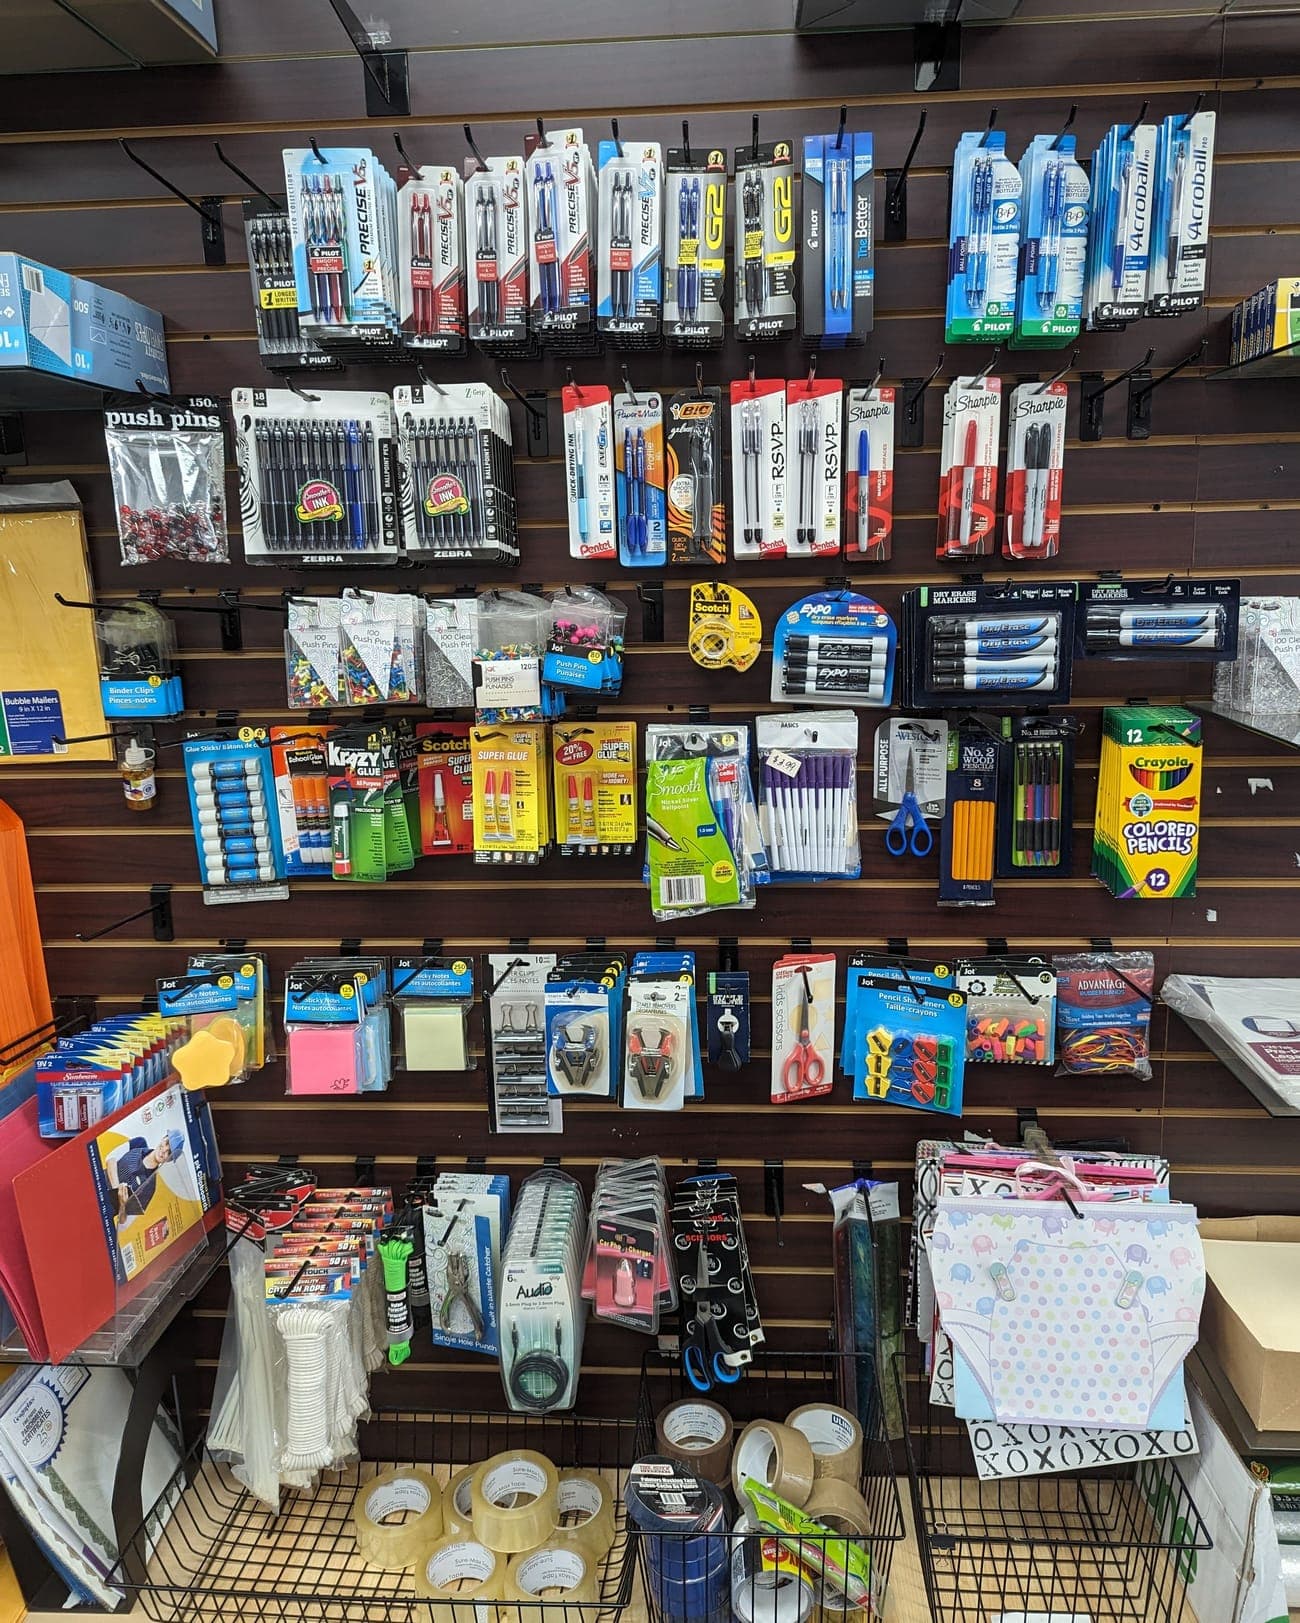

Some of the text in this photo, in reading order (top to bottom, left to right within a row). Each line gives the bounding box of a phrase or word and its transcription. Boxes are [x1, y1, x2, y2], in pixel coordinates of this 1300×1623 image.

[1186, 148, 1207, 240] Acroball
[569, 184, 577, 234] PRECISE
[774, 176, 792, 243] G2
[1130, 161, 1148, 252] Acroball
[355, 187, 372, 255] PRECISE
[641, 198, 650, 246] PRECISE
[706, 184, 724, 250] G2
[507, 208, 516, 254] PRECISE
[441, 219, 450, 266] PRECISE
[74, 300, 89, 314] 500
[1171, 297, 1199, 306] PILOT
[554, 312, 578, 321] PILOT
[1112, 307, 1139, 315] PILOT
[684, 326, 710, 334] PILOT
[758, 321, 783, 329] PILOT
[984, 322, 1012, 332] PILOT
[1052, 324, 1078, 333] PILOT
[490, 329, 514, 337] PILOT
[424, 338, 448, 346] PILOT
[254, 392, 265, 400] 18
[955, 394, 1000, 412] Sharpie
[1016, 398, 1066, 418] Sharpie
[616, 407, 661, 420] Paper Mate
[682, 404, 710, 416] BIC
[850, 404, 891, 422] Sharpie
[105, 408, 221, 431] push pins
[647, 442, 656, 471] Profile
[568, 448, 577, 502] QUICK-DRYING
[439, 490, 454, 502] INK
[653, 522, 661, 532] 2
[580, 540, 612, 555] Pentel
[759, 539, 786, 552] Pentel
[810, 540, 838, 552] Pentel
[302, 555, 344, 563] ZEBRA
[694, 602, 730, 613] Scotch
[800, 604, 832, 618] EXPO
[1136, 617, 1188, 628] Dry Erase
[981, 625, 1000, 634] Dry
[353, 636, 391, 646] Push Pins
[982, 640, 1000, 649] Dry
[551, 644, 564, 653] Jot
[556, 660, 588, 671] Push Pins
[556, 668, 586, 680] Punaises
[820, 667, 849, 678] EXPO
[980, 677, 999, 686] Dry
[134, 686, 154, 696] Clips
[5, 696, 58, 706] Bubble Mailers
[243, 728, 250, 737] 8
[1126, 728, 1143, 744] 12
[422, 740, 471, 752] Scotch
[563, 744, 583, 756] 20%
[602, 742, 630, 750] SUPER
[658, 740, 672, 749] Jot
[328, 742, 380, 768] Krazy
[477, 751, 528, 760] SUPER GLUE
[572, 750, 588, 760] FREE
[597, 750, 617, 759] GLUE
[963, 746, 994, 758] No. 2
[962, 756, 994, 764] WOOD
[1134, 756, 1188, 770] Crayola
[357, 767, 382, 776] GLUE
[878, 739, 889, 793] ALL PURPOSE
[651, 766, 702, 797] Smooth
[974, 778, 982, 787] 8
[1123, 822, 1197, 838] COLORED
[1128, 838, 1192, 854] PENCILS
[286, 854, 293, 863] 3
[1150, 873, 1167, 887] 12
[398, 960, 410, 968] Jot
[852, 958, 866, 967] Jot
[868, 971, 890, 979] Pencil
[936, 968, 946, 976] 12
[861, 978, 876, 986] Jot
[1040, 974, 1050, 983] 40
[162, 981, 176, 989] Jot
[290, 982, 302, 990] Jot
[1078, 978, 1127, 991] ADVANTAGE
[304, 997, 323, 1005] Sticky
[878, 992, 902, 1001] Pencil
[950, 996, 961, 1004] 12
[186, 997, 232, 1008] autocollantes
[885, 1002, 938, 1018] Taille-crayons
[776, 984, 785, 1051] kids scissors
[63, 1071, 98, 1080] Sunbeam
[196, 1168, 208, 1212] Clipboards
[599, 1238, 652, 1258] Car Charger
[484, 1246, 493, 1275] Catcher
[304, 1284, 326, 1292] ROPE
[516, 1282, 553, 1300] Audio
[434, 1333, 498, 1352] Single Hole Punch
[22, 1406, 45, 1437] PARCHMENT
[22, 1409, 51, 1446] CERTIFICATES
